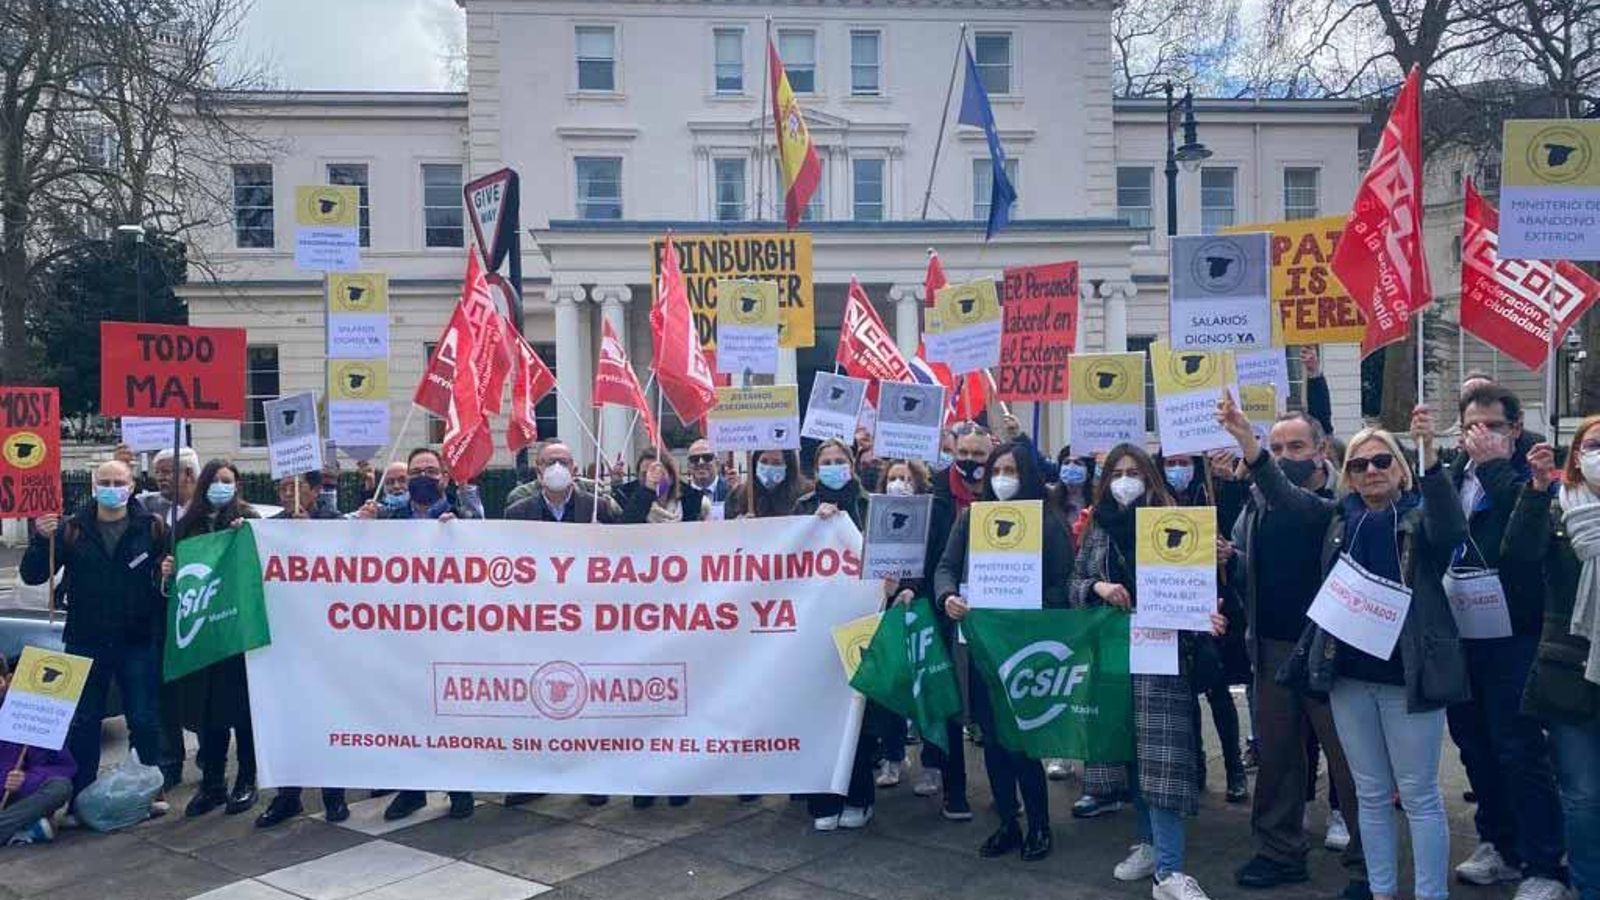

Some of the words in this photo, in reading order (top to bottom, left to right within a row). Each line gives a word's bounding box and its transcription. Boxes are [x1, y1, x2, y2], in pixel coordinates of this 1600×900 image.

[475, 183, 500, 209] GIVE
[1511, 200, 1580, 211] MINISTERIO
[480, 209, 496, 223] WAY
[1517, 216, 1595, 226] ABANDONO
[1524, 231, 1585, 241] EXTERIOR
[1004, 274, 1023, 301] El
[1025, 265, 1078, 299] Personal
[1285, 267, 1328, 295] IS
[1191, 314, 1248, 327] SALARIOS
[137, 334, 215, 363] TODO
[1185, 333, 1234, 345] DIGNOS
[1237, 332, 1256, 344] YA
[999, 363, 1065, 394] EXISTE
[126, 375, 219, 410] MAL
[264, 555, 537, 588] ABANDONAD@S
[550, 556, 575, 584] Y
[587, 555, 688, 584] BAJO
[701, 547, 861, 583] MÍNIMOS
[974, 562, 1022, 572] MINISTERIO
[1023, 563, 1036, 571] DE
[979, 575, 1030, 584] ABANDONO
[327, 602, 582, 631] CONDICIONES
[595, 602, 739, 631] DIGNAS
[751, 599, 797, 628] YA
[1010, 664, 1090, 699] CSIF
[329, 733, 421, 748] PERSONAL
[426, 736, 507, 750] LABORAL
[512, 738, 542, 751] SIN
[548, 738, 644, 752] CONVENIO
[651, 738, 674, 751] EN
[679, 739, 700, 752] EL
[706, 738, 800, 753] EXTERIOR
